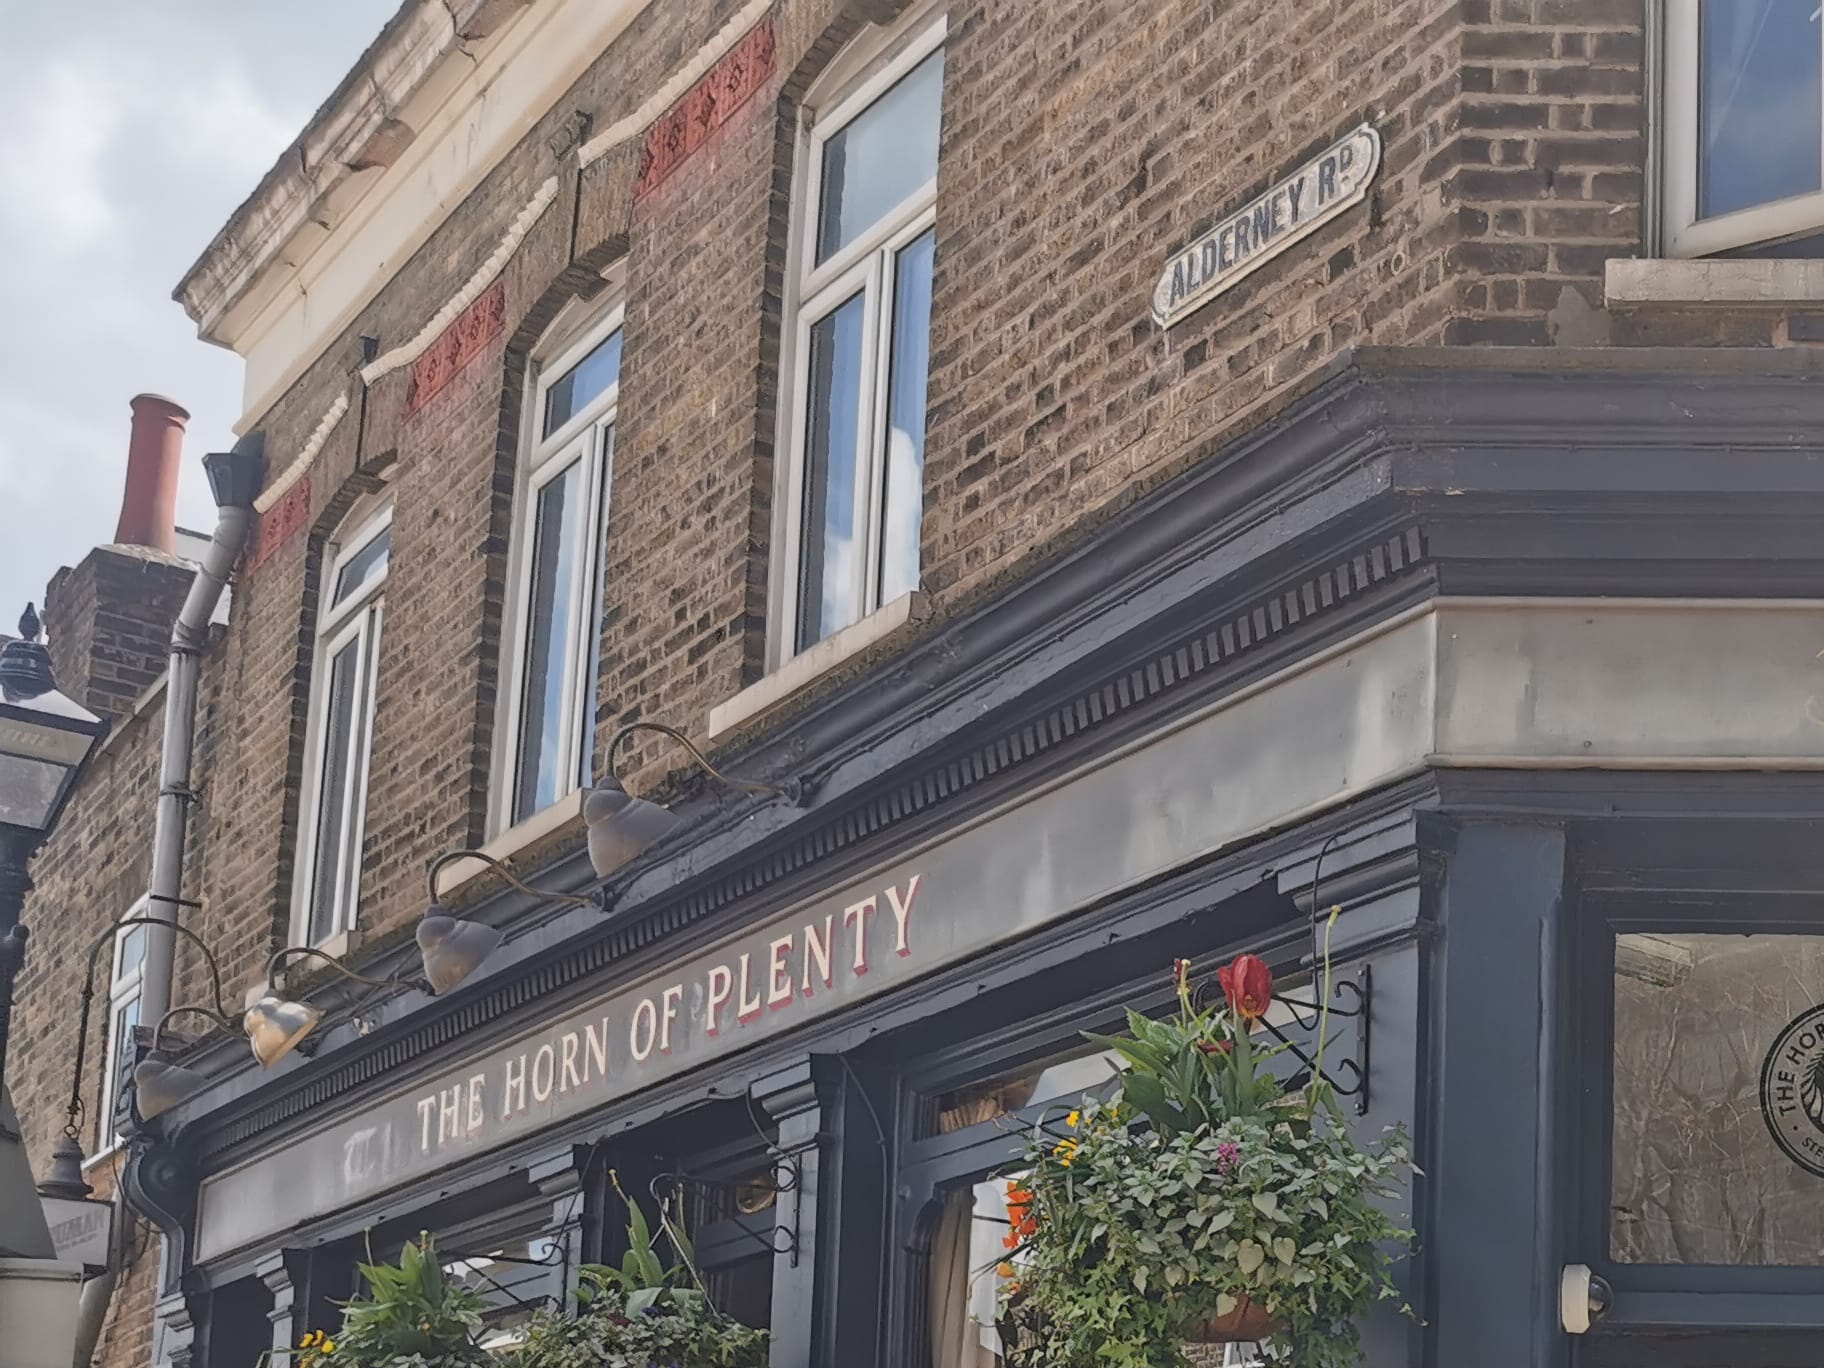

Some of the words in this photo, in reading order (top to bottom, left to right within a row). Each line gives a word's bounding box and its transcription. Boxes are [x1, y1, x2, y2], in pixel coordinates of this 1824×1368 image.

[1169, 176, 1305, 308] ALDERNEY
[417, 1072, 487, 1154] THE
[503, 1016, 609, 1120] HORN
[629, 984, 683, 1058] OF
[704, 873, 923, 1037] PLENTY
[1776, 1070, 1797, 1117] THE
